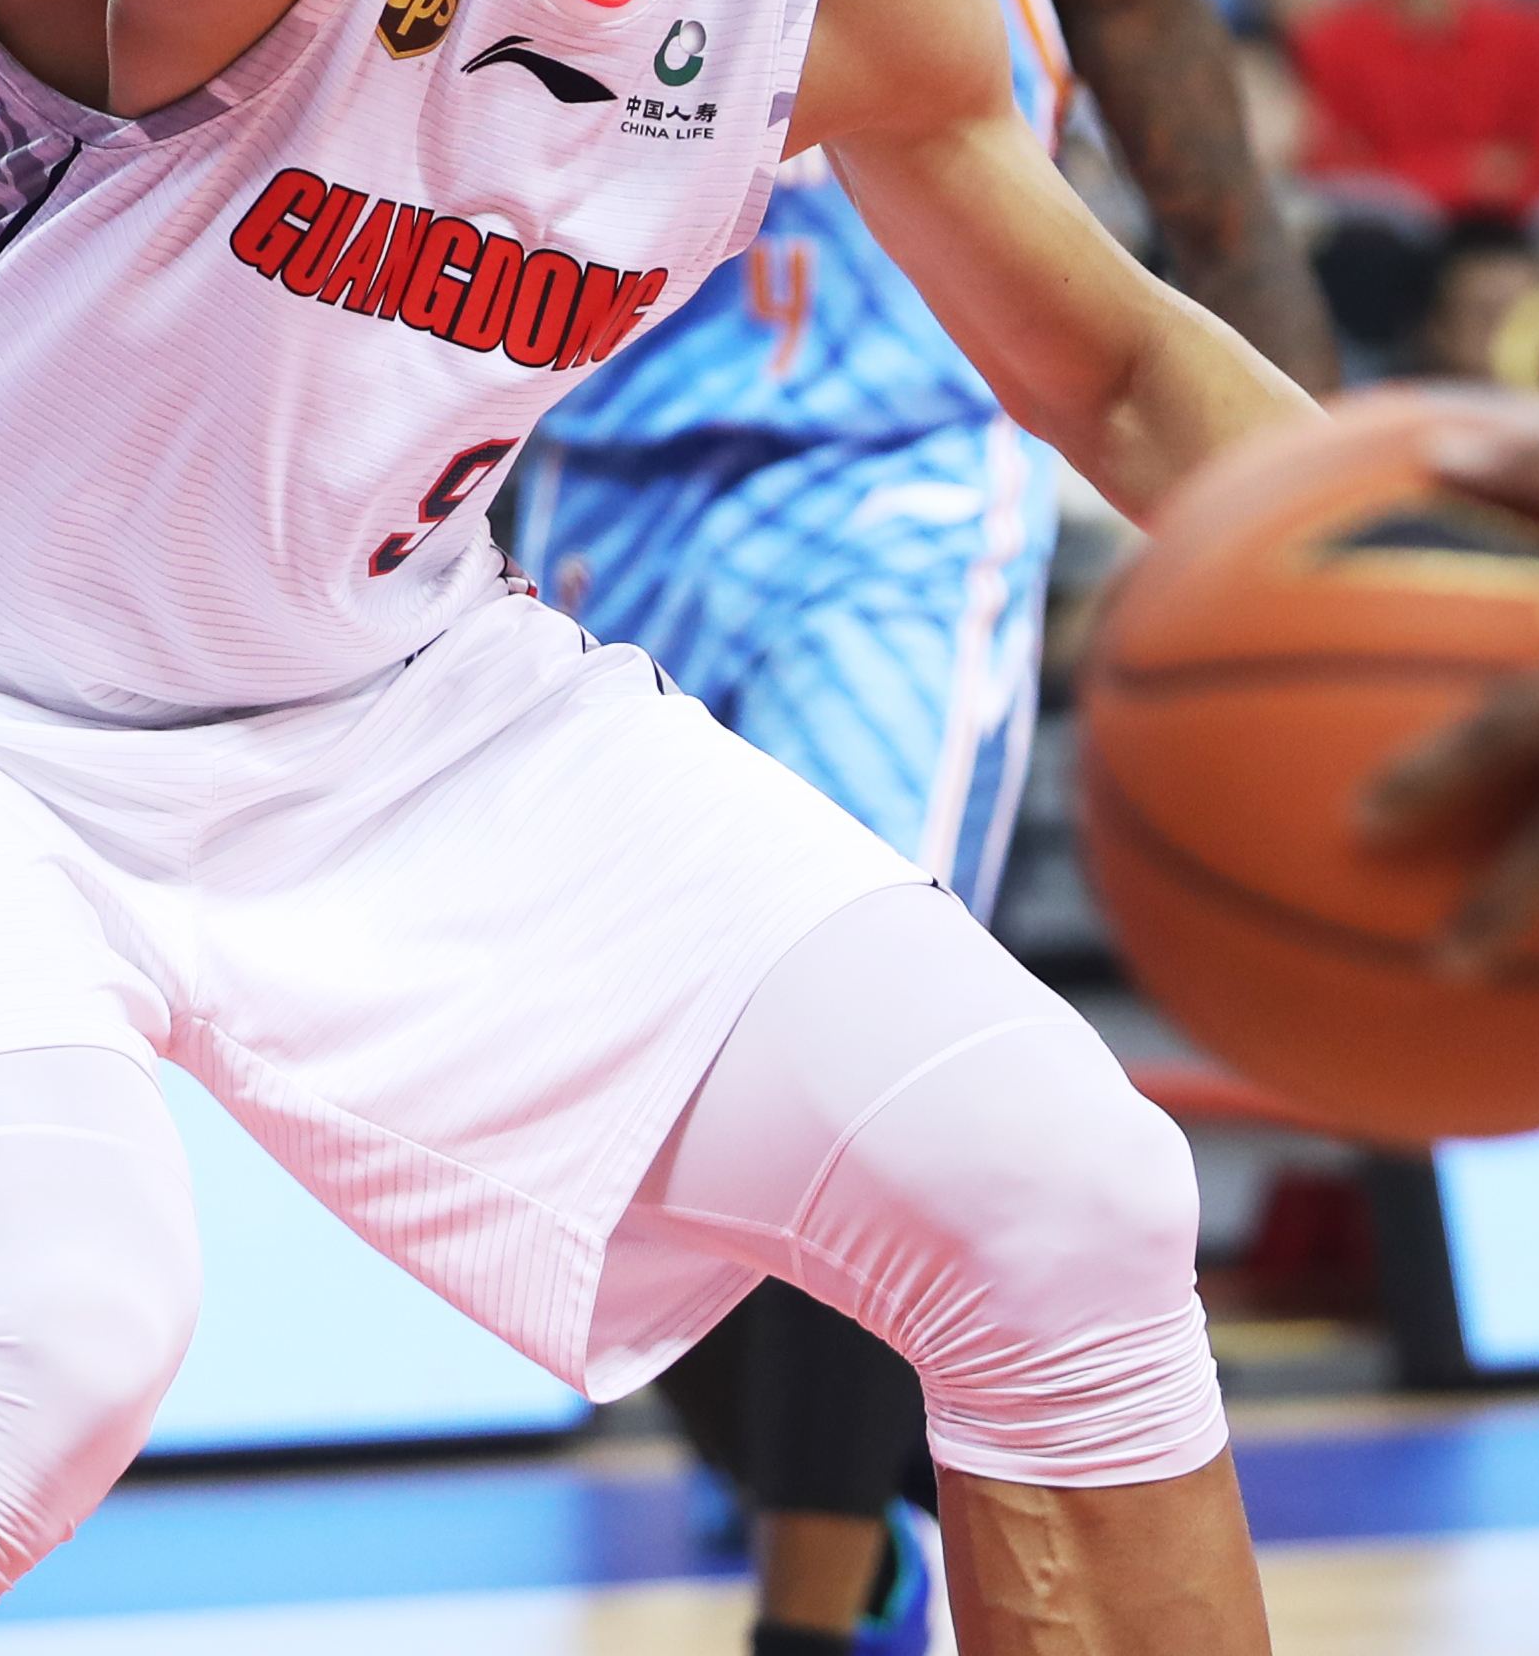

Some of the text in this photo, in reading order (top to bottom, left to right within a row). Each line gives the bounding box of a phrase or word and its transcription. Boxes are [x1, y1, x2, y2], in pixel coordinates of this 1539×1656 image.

[625, 94, 719, 124] 中国人寿
[620, 121, 716, 140] CHINA LIFE
[228, 166, 669, 372] GUANGDONG
